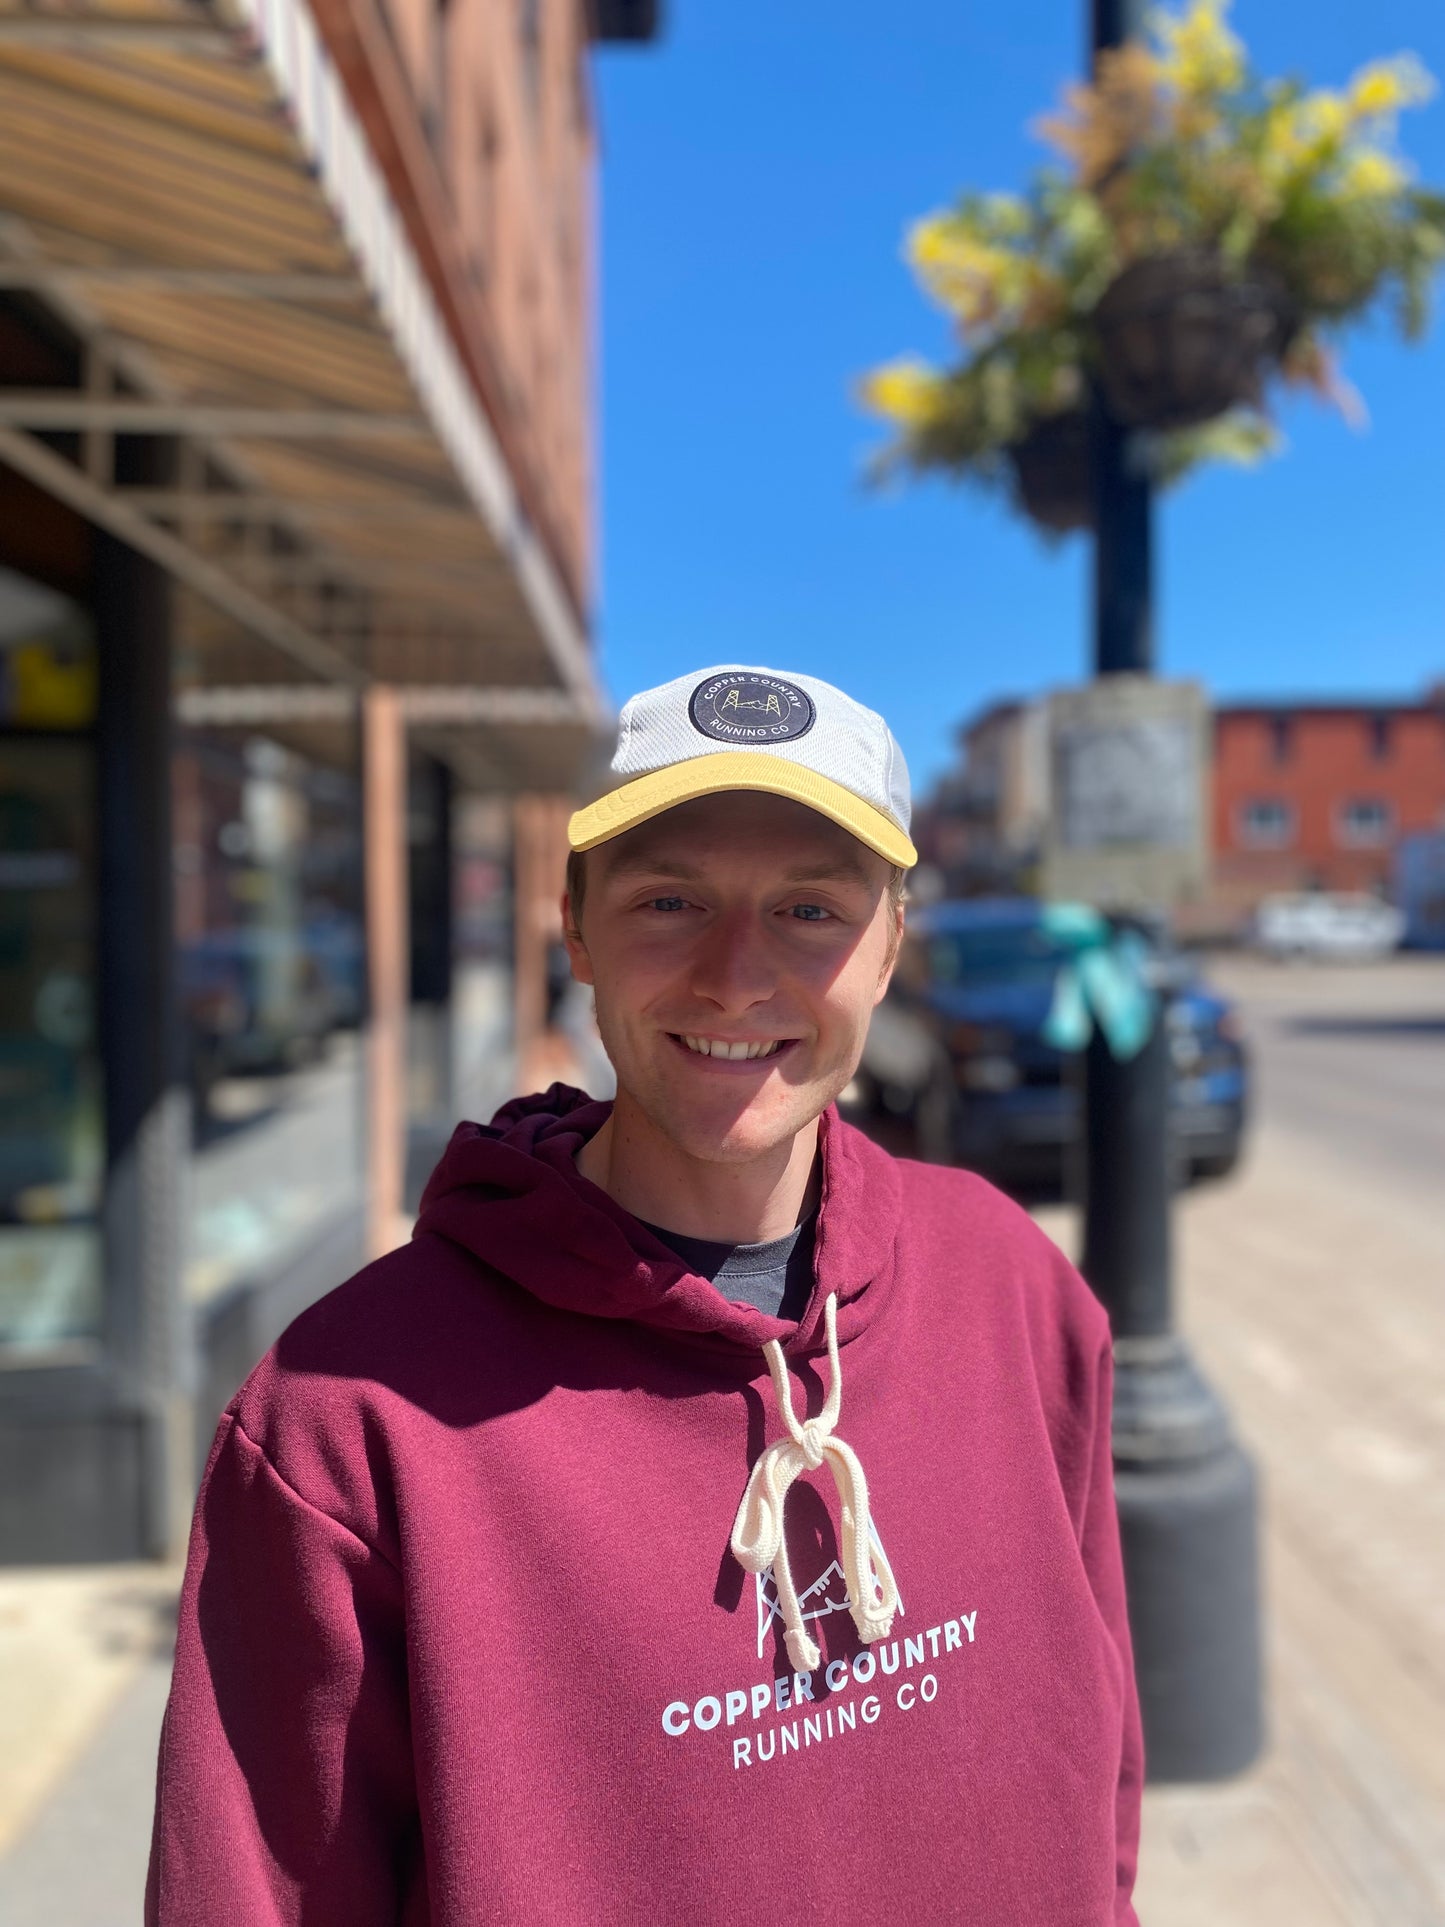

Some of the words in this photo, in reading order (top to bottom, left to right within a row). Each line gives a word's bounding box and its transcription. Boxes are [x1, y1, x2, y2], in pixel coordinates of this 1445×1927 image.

[704, 676, 745, 700] COPPER
[750, 677, 802, 708] COUNTRY
[710, 718, 767, 736] RUNNING
[771, 725, 789, 735] CO
[661, 1671, 816, 1736] COPPER
[825, 1611, 978, 1692] COUNTRY
[733, 1696, 881, 1770] RUNNING
[896, 1674, 938, 1711] CO
